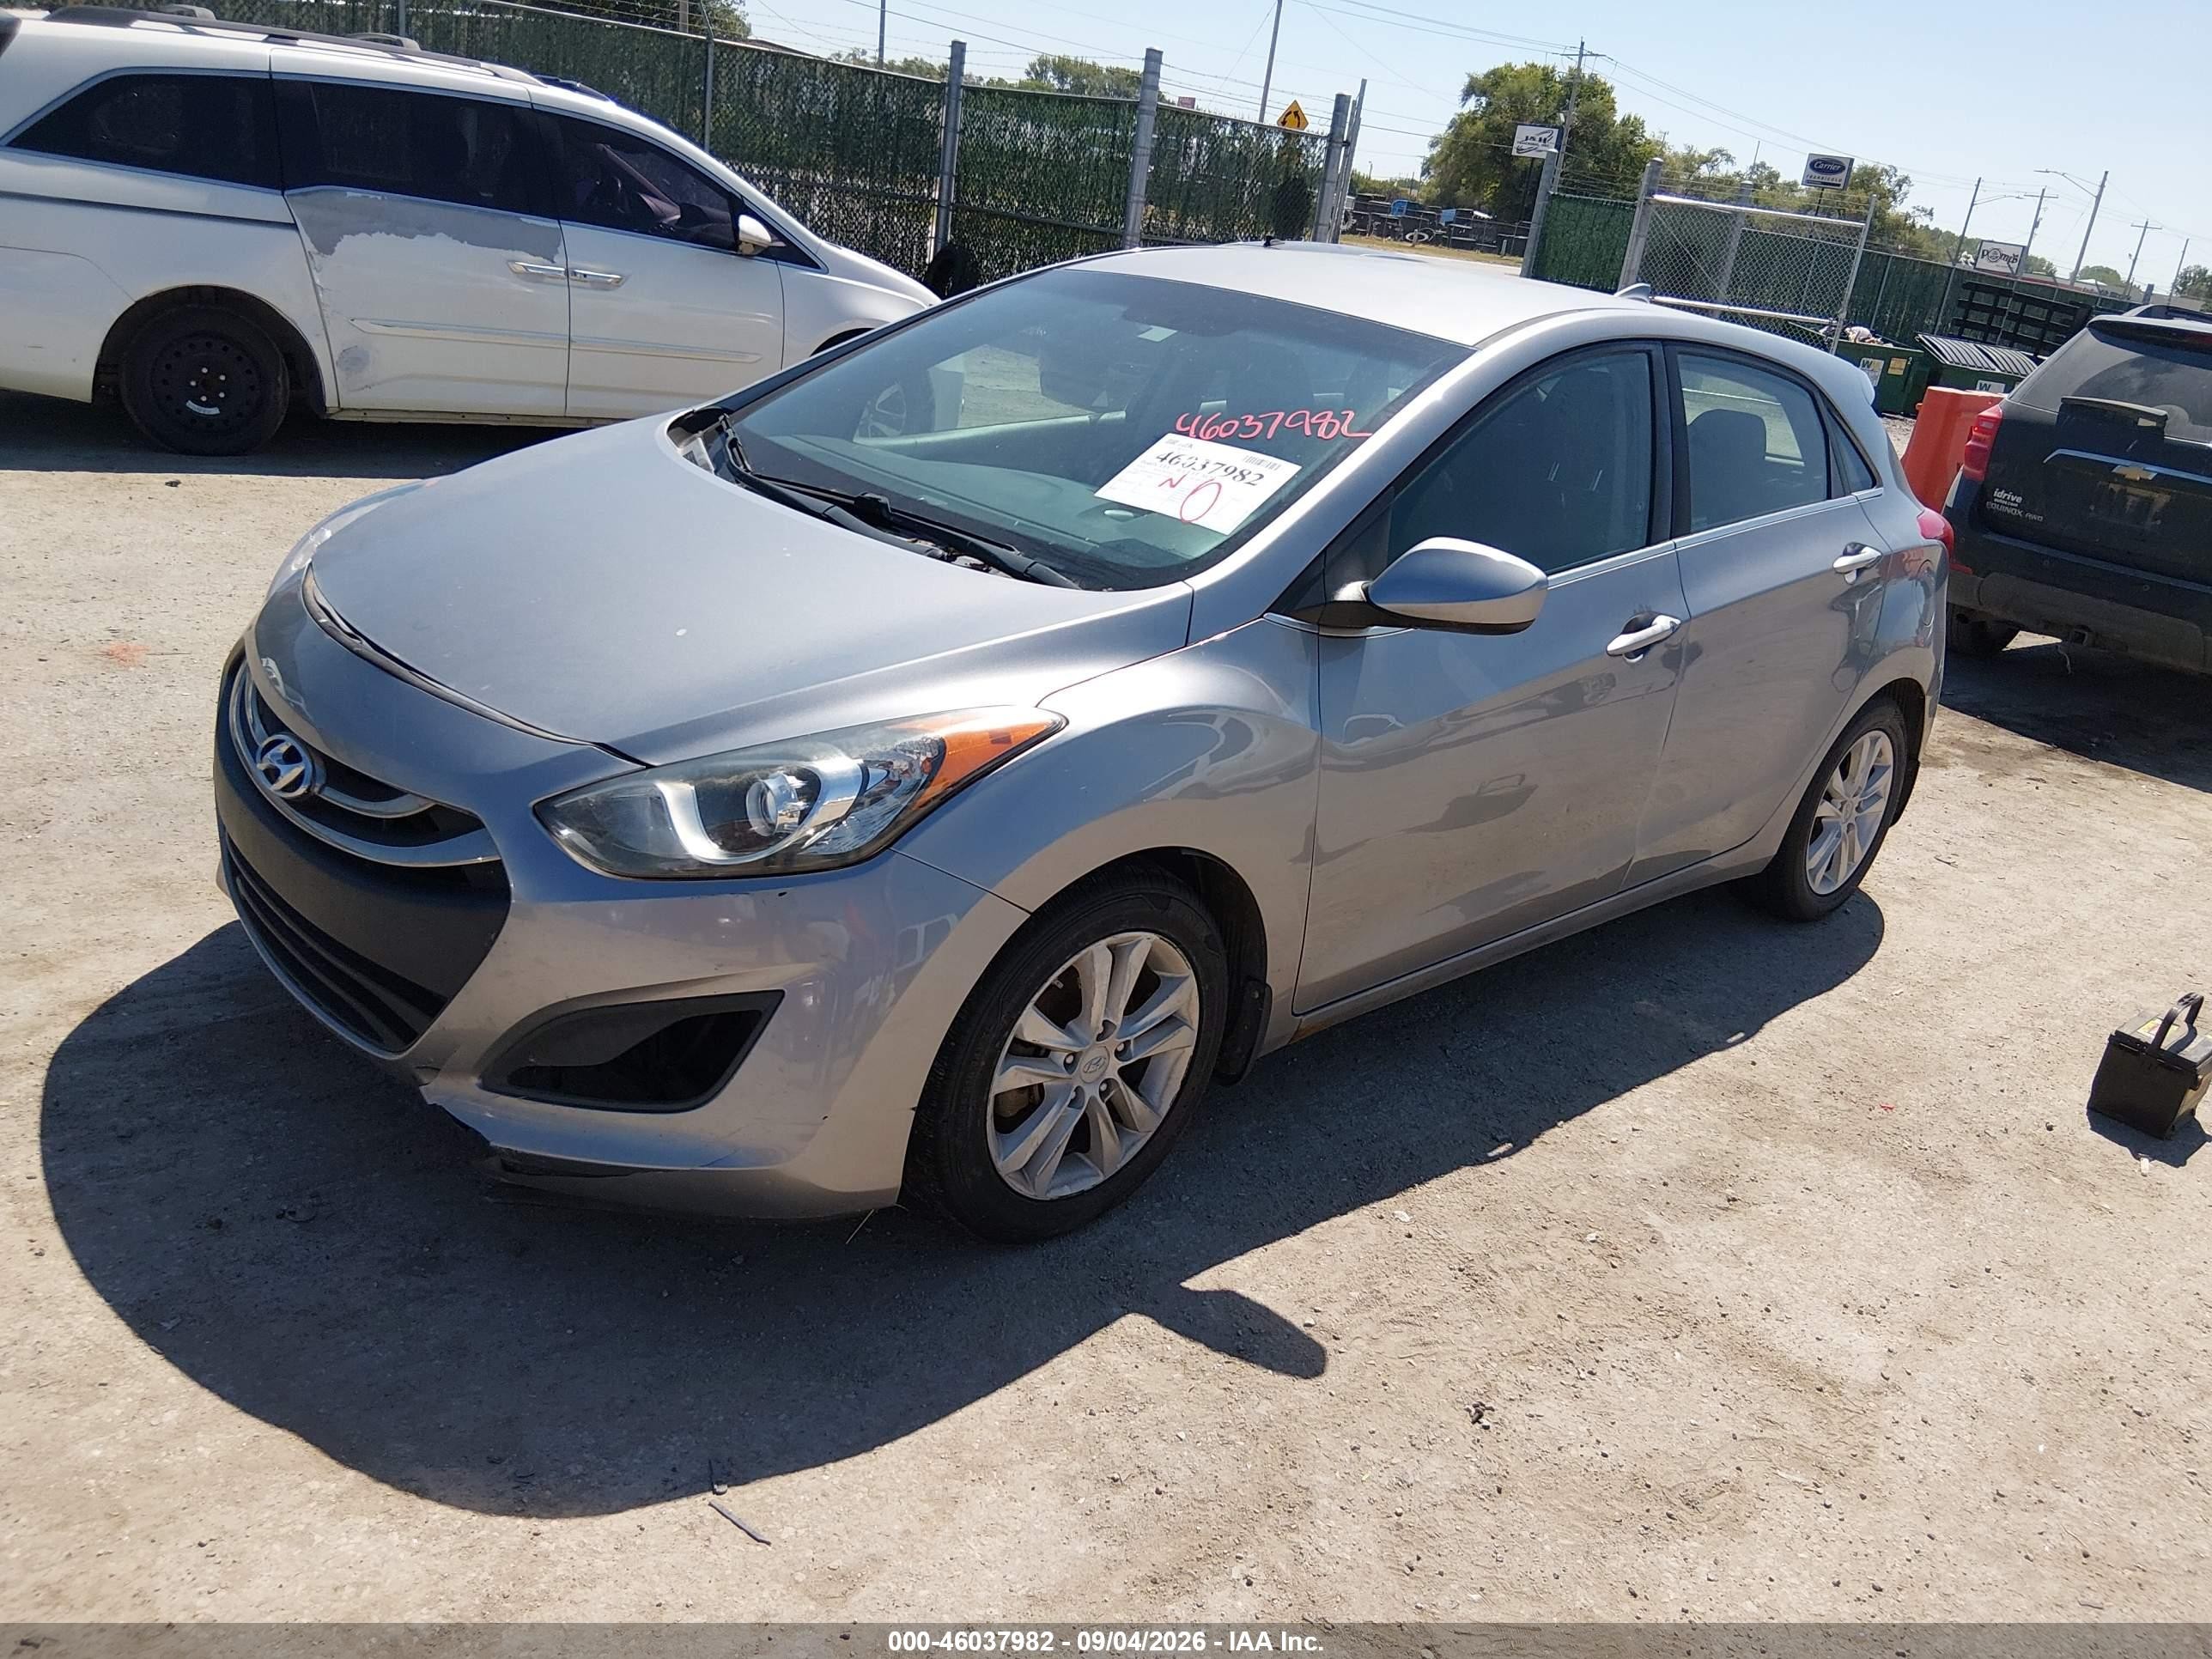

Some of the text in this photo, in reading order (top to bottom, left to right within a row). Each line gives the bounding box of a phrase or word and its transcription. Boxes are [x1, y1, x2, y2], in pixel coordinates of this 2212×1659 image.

[1814, 161, 1841, 171] Carrier
[1176, 410, 1373, 441] 46037982
[1156, 452, 1265, 487] 46037982
[1993, 488, 2023, 503] idrive
[1985, 501, 2024, 517] EQUINOX
[2025, 512, 2044, 522] AWD
